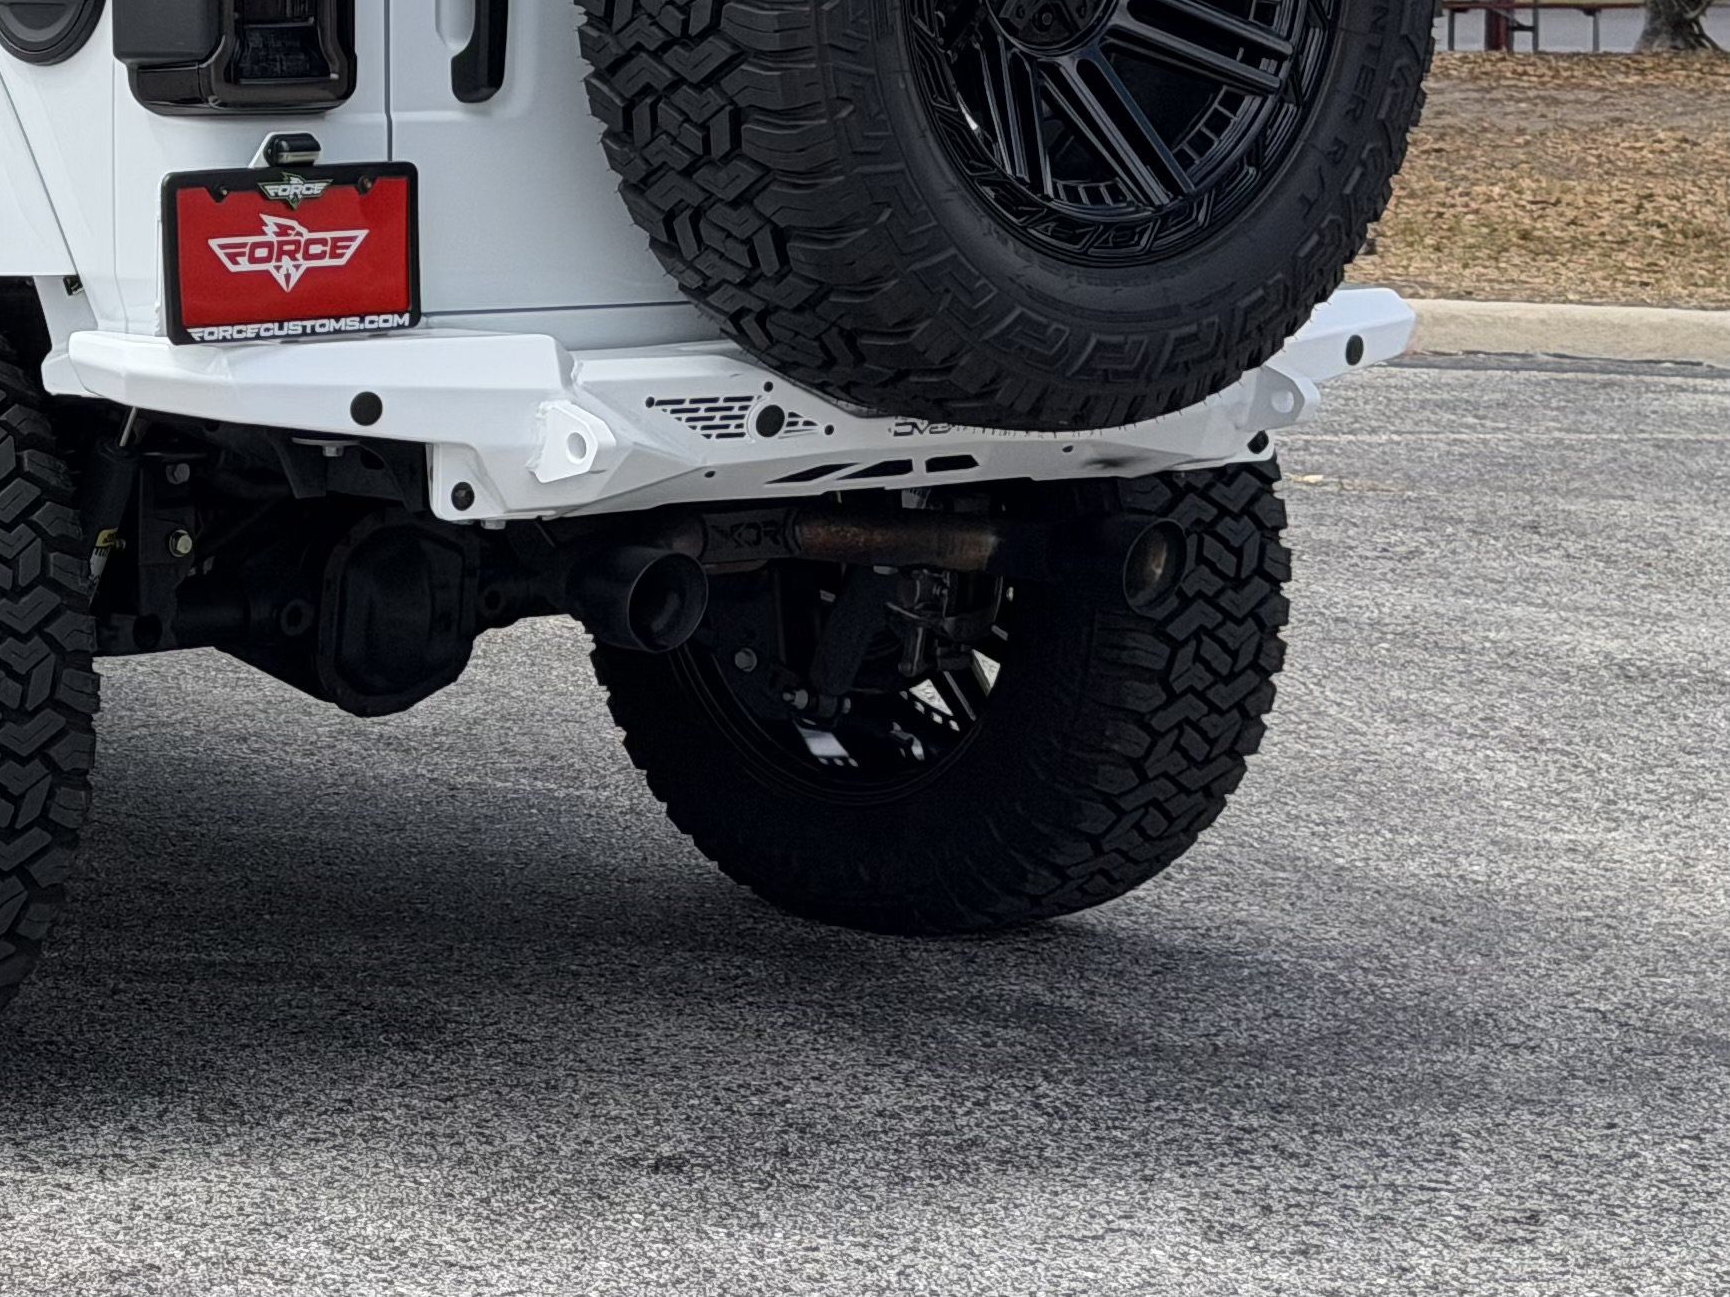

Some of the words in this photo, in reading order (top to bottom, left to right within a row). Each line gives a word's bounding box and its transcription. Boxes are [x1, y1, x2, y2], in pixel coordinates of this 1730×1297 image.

[264, 182, 328, 197] FORCE
[216, 235, 362, 266] FORCE
[186, 313, 410, 342] FORCECUSTOMS.COM
